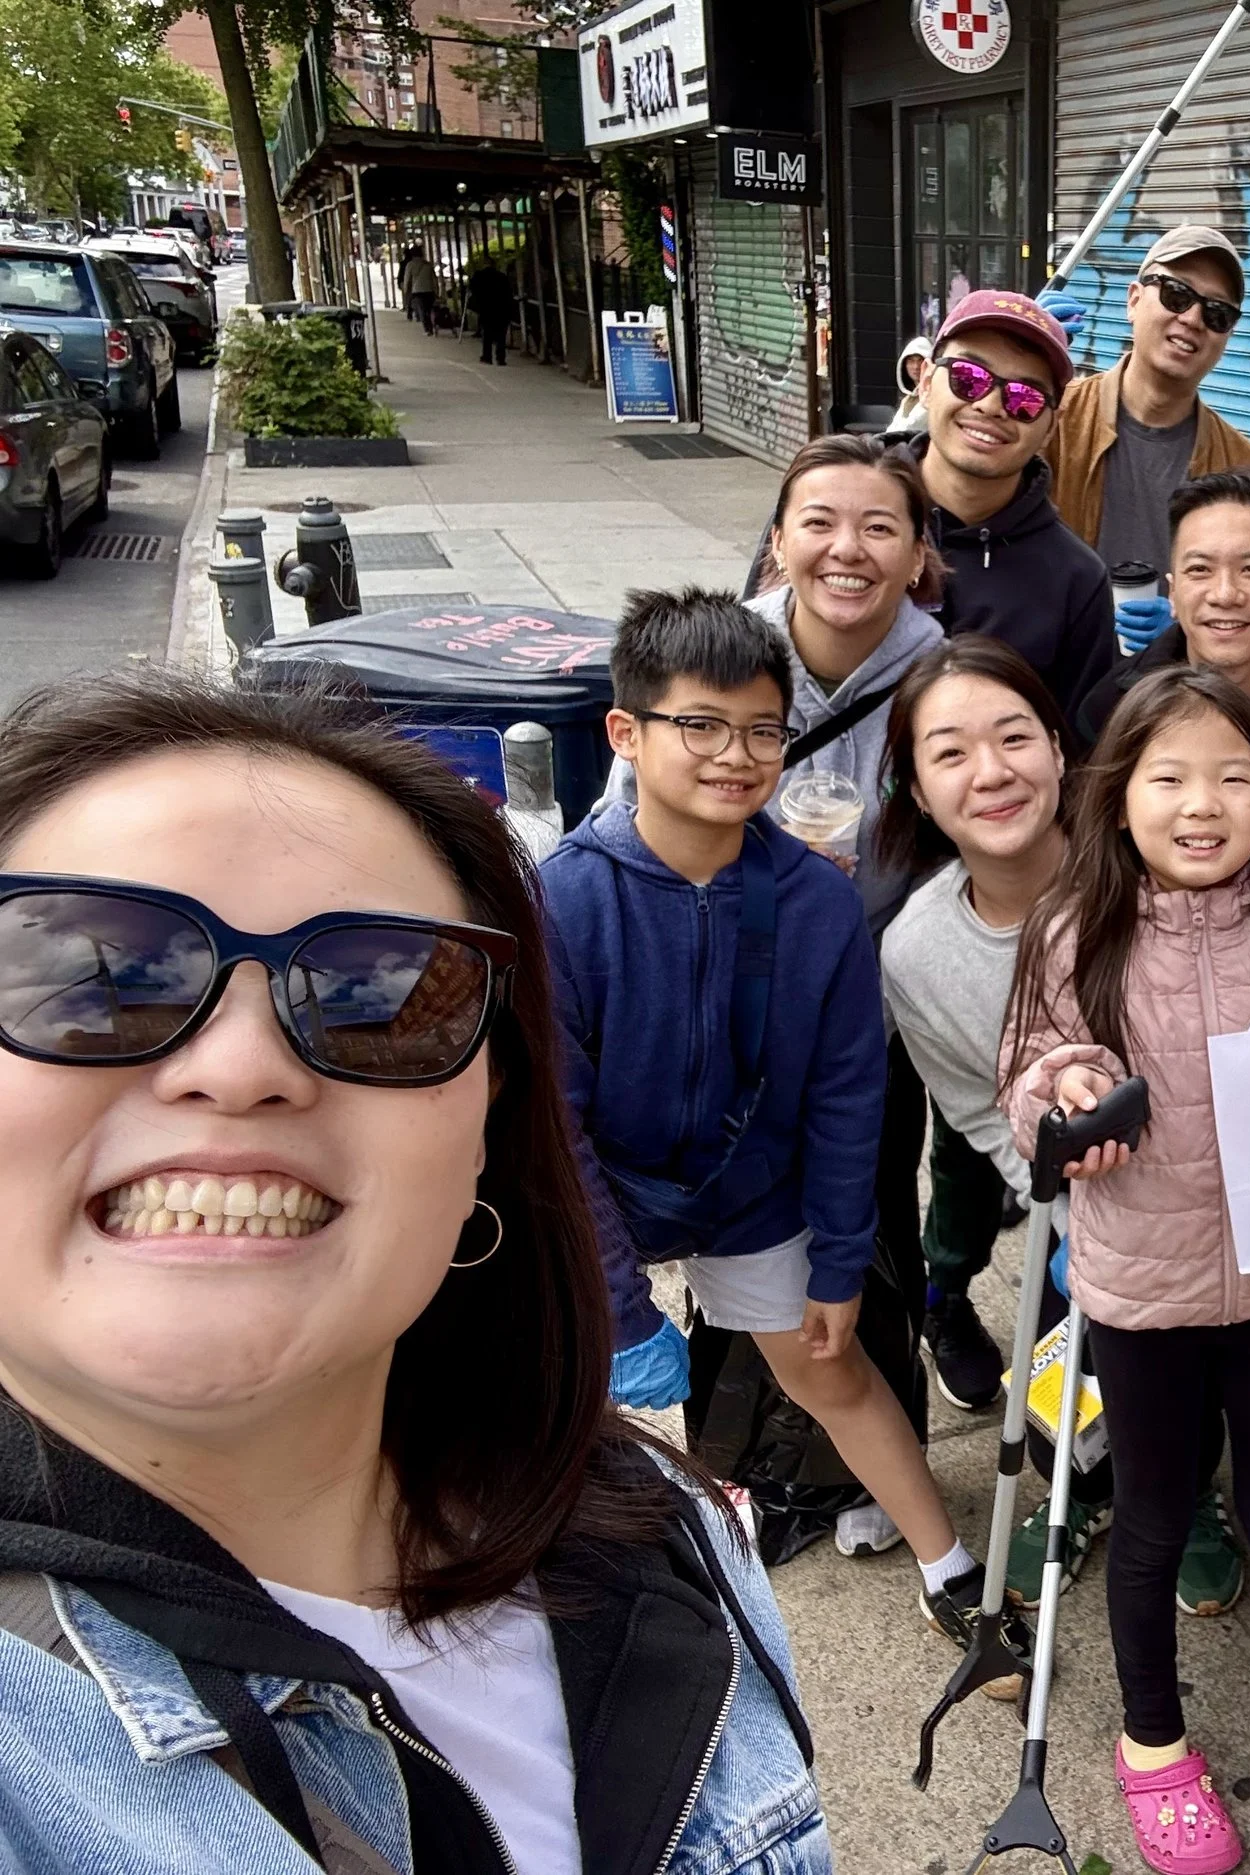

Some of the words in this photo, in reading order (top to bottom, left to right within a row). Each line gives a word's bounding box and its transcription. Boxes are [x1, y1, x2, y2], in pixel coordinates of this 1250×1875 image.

[969, 21, 1008, 69] PHARMACY
[734, 147, 806, 184] ELM
[735, 179, 806, 192] ROASTERY
